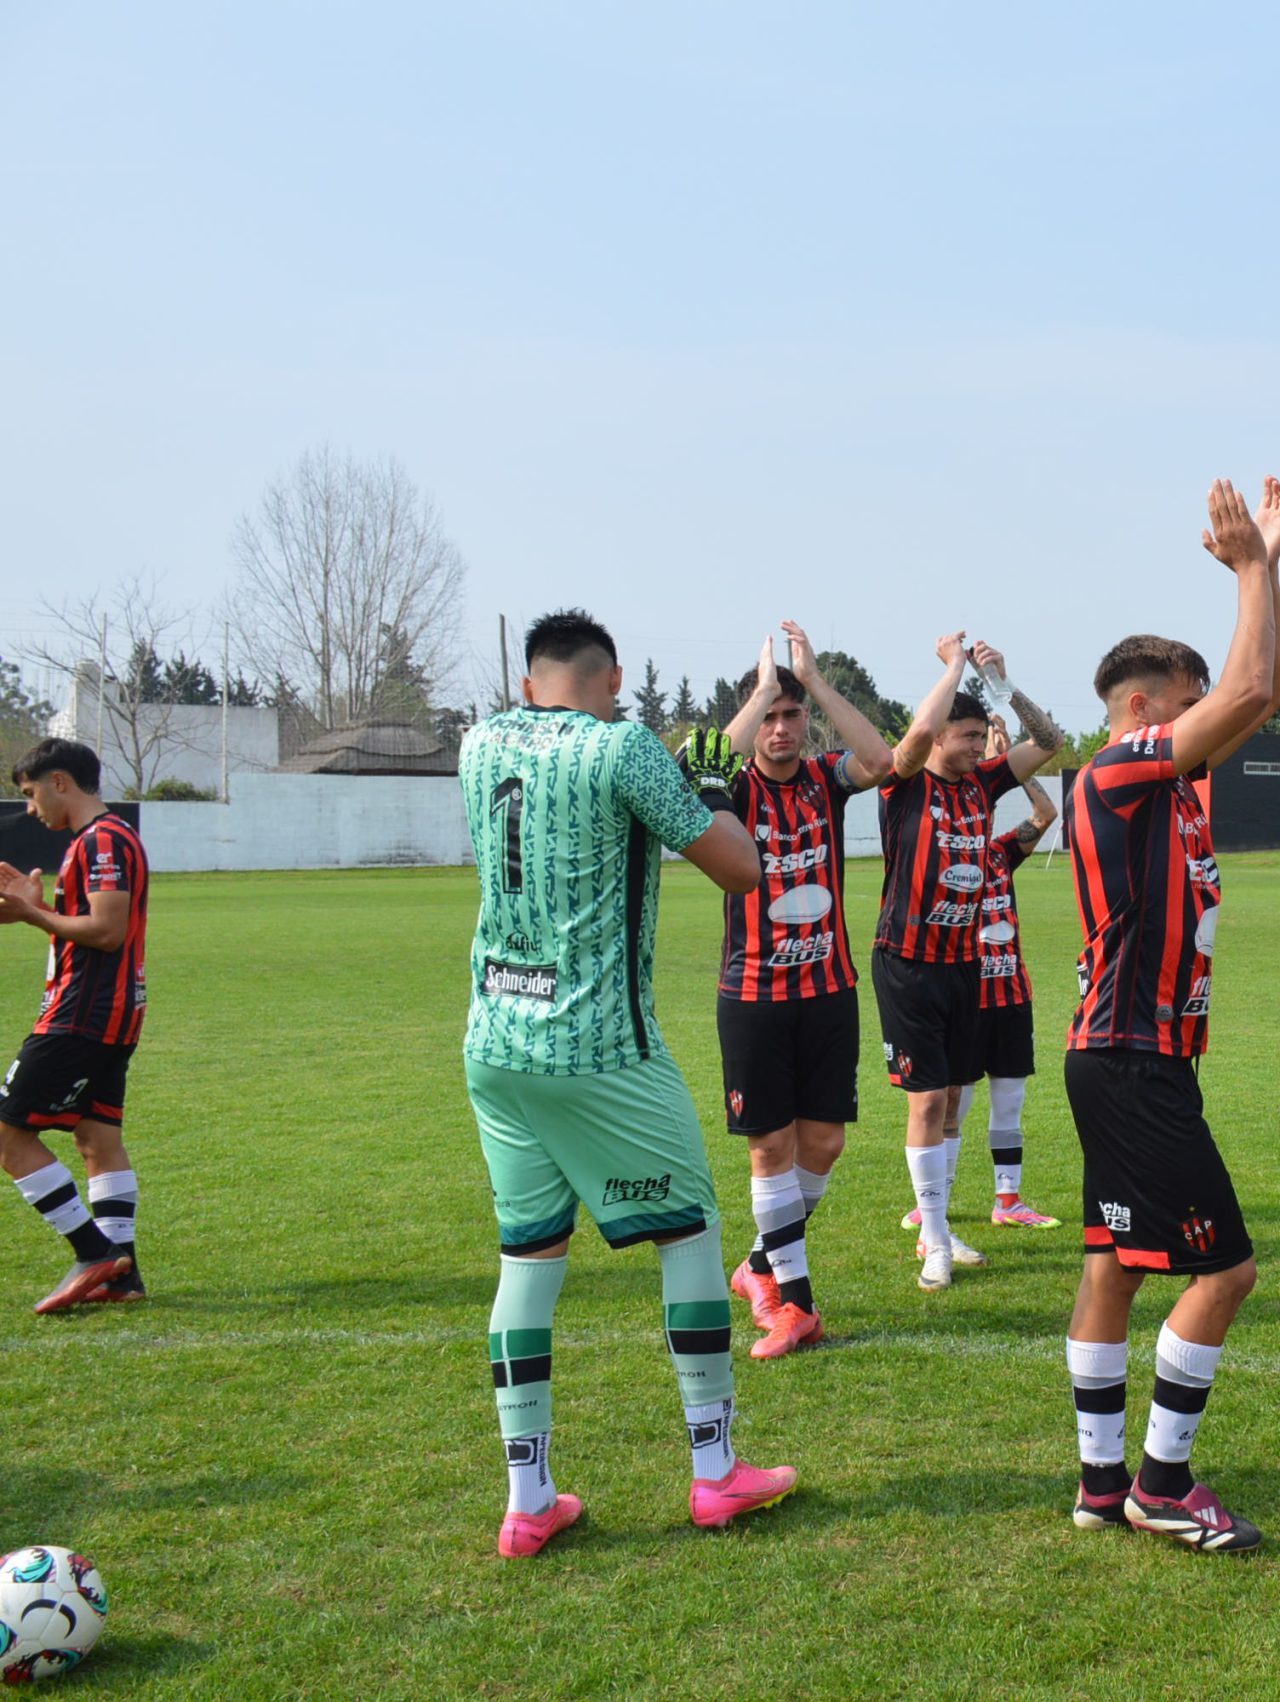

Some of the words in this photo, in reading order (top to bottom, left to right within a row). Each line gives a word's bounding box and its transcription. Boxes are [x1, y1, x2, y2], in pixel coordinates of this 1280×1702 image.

[489, 777, 524, 895] 1
[764, 844, 828, 874] ESCO
[981, 894, 1012, 912] SCO
[768, 945, 832, 966] BUS
[485, 965, 557, 996] Schneider
[605, 1174, 671, 1191] flecha
[602, 1188, 669, 1206] BUS
